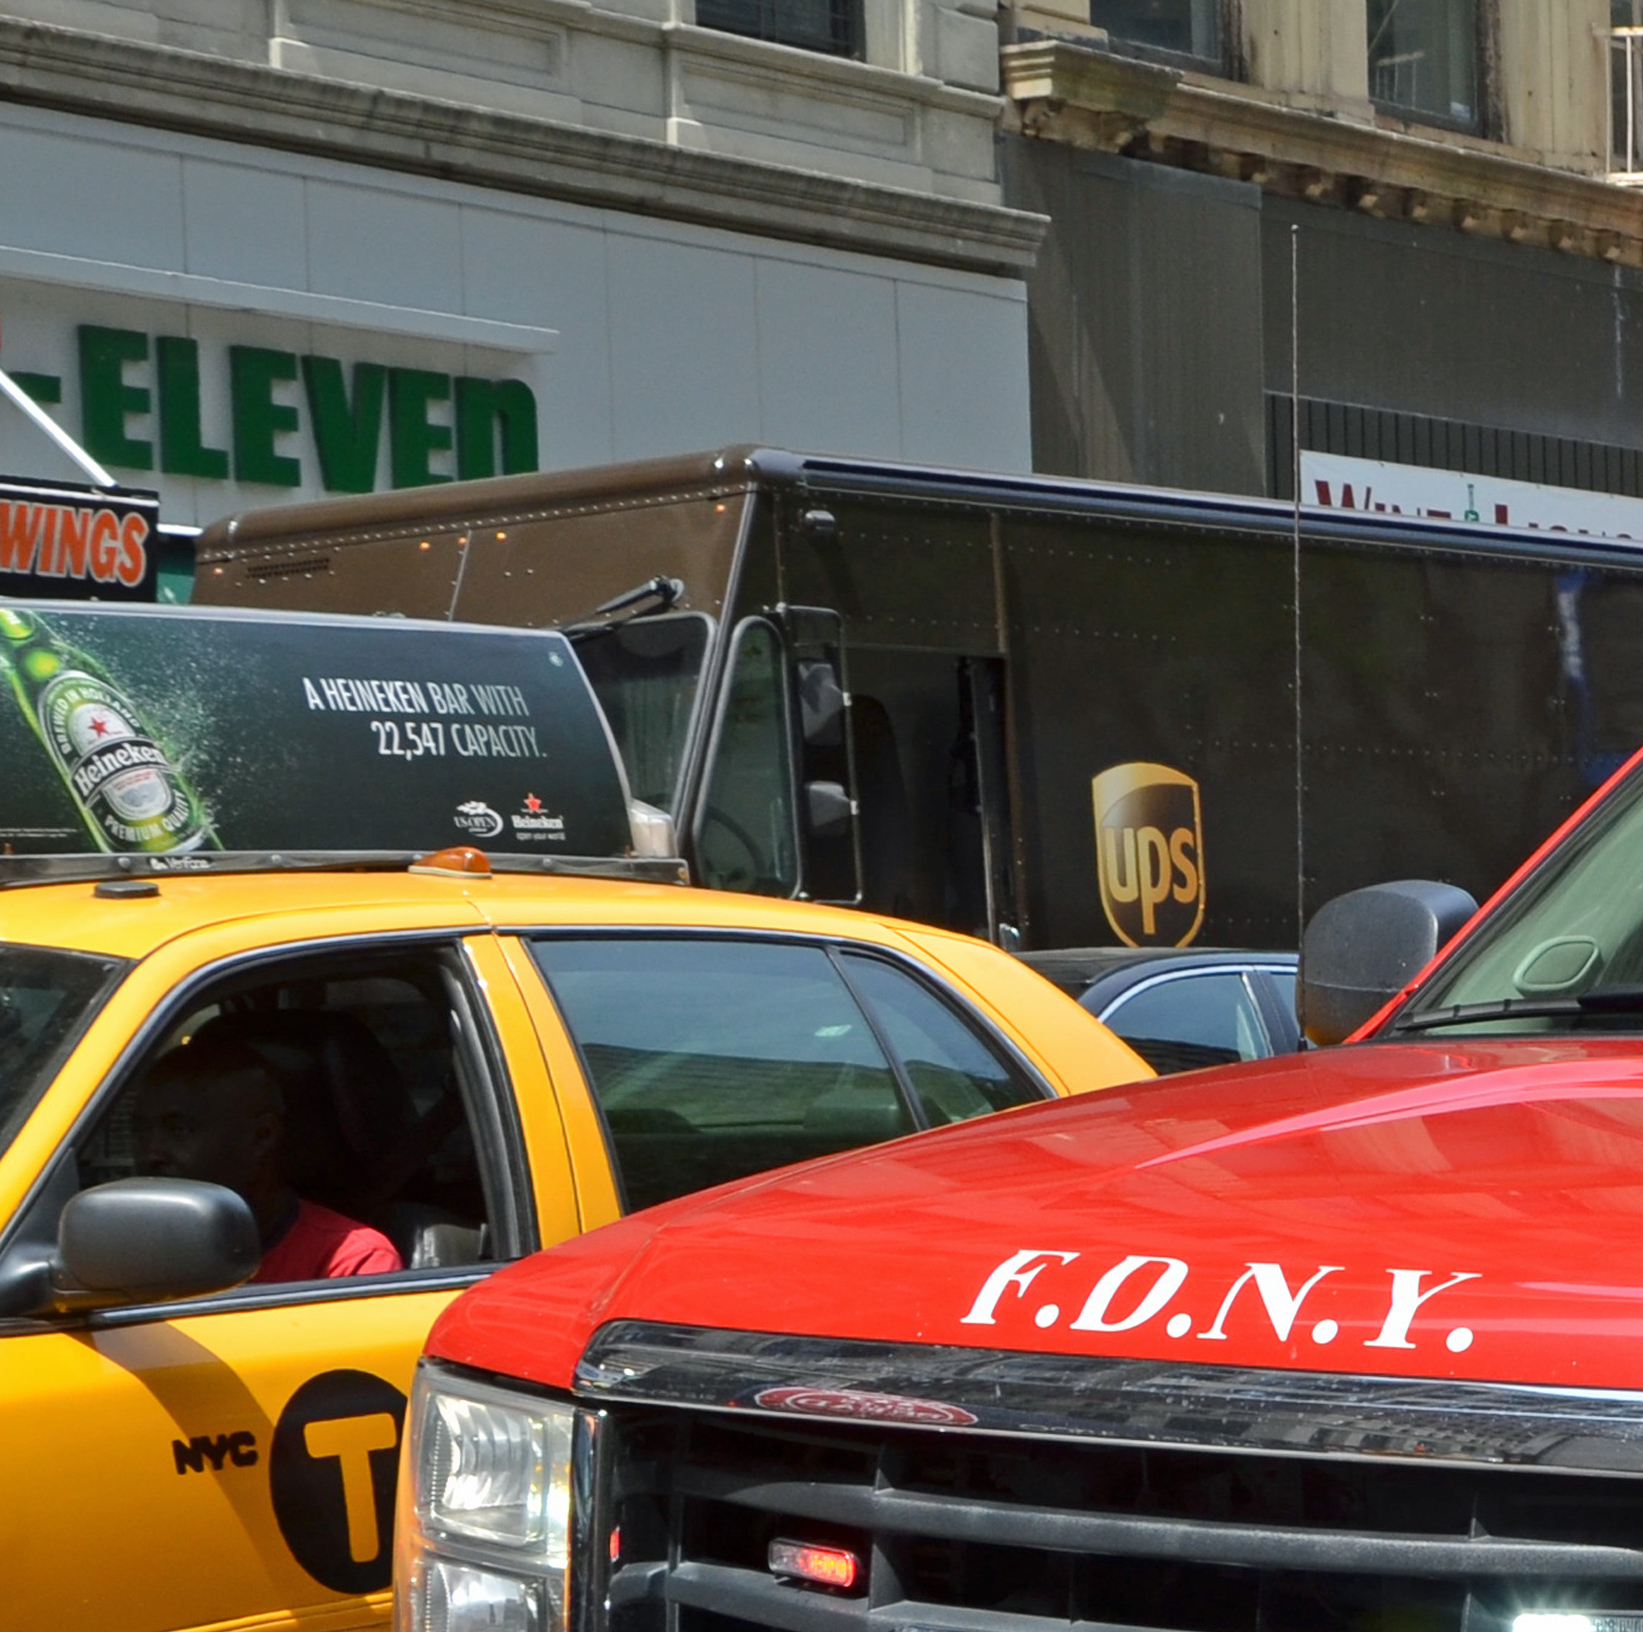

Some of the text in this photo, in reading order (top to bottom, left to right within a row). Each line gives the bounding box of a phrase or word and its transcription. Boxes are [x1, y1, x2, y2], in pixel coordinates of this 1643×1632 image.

[0, 502, 147, 587] WINGS
[302, 677, 530, 716] A HEINEKEN BAR WITH
[370, 721, 548, 761] 22,547 CAPACITY.
[73, 742, 166, 797] Heineken
[104, 813, 164, 842] PREMIUM
[1101, 823, 1200, 935] ups
[961, 1248, 1482, 1353] F.D.N.Y.
[171, 1430, 259, 1476] NYC
